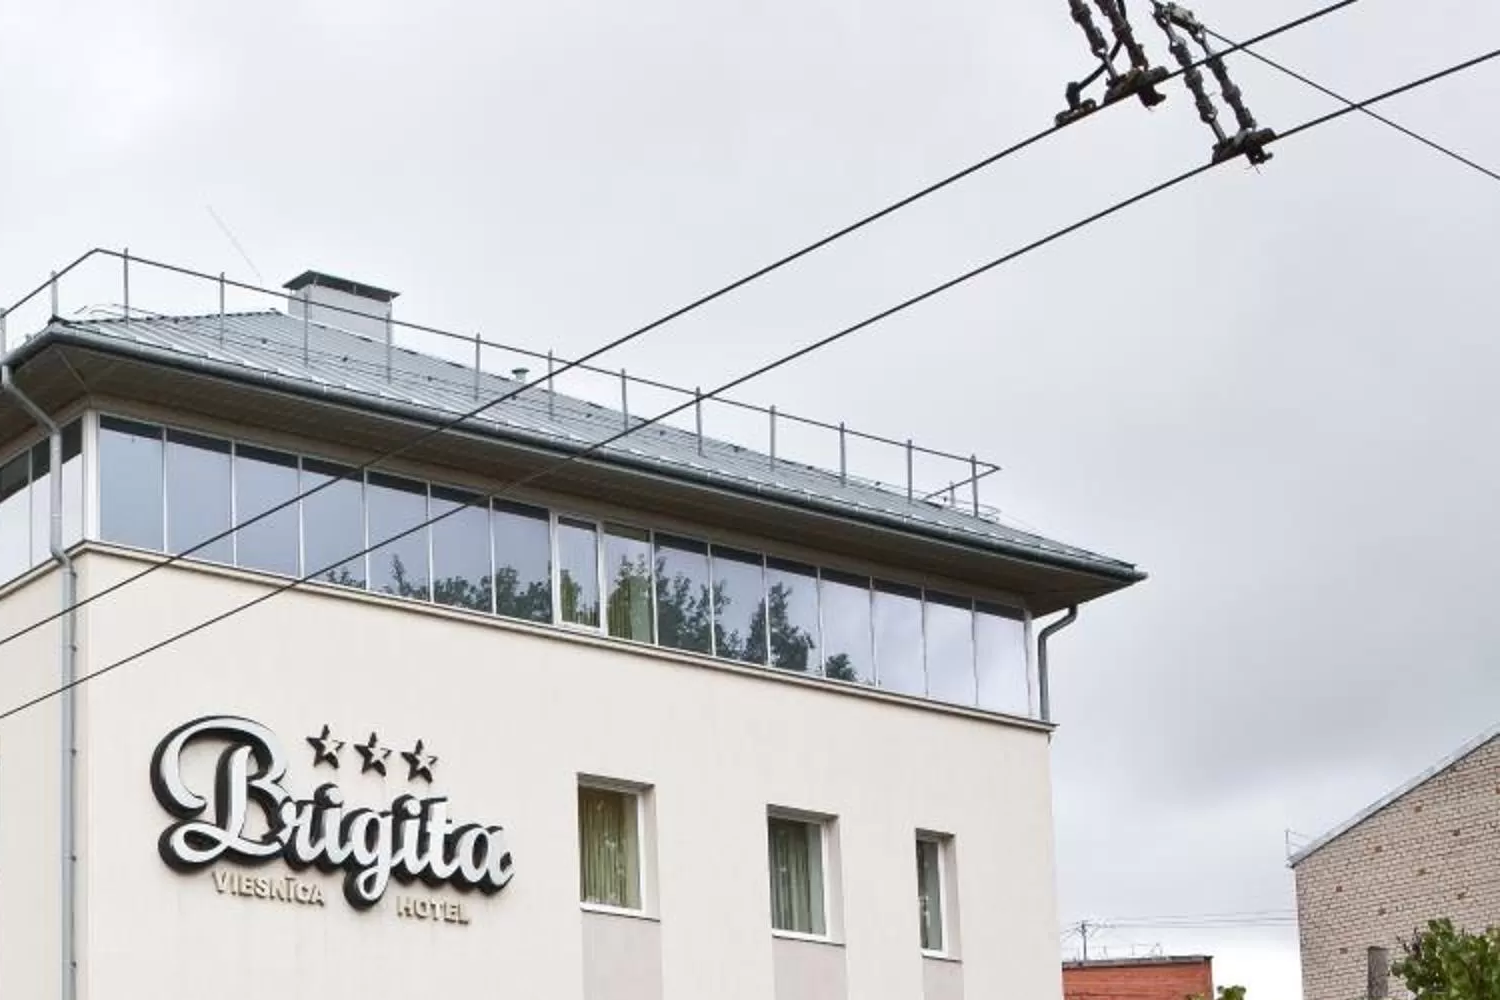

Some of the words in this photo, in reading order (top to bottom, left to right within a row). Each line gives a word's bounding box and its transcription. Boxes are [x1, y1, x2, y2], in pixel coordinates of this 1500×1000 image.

[150, 715, 514, 910] Brigita
[212, 870, 326, 907] VIESNĪCA
[397, 897, 470, 925] HOTEL
